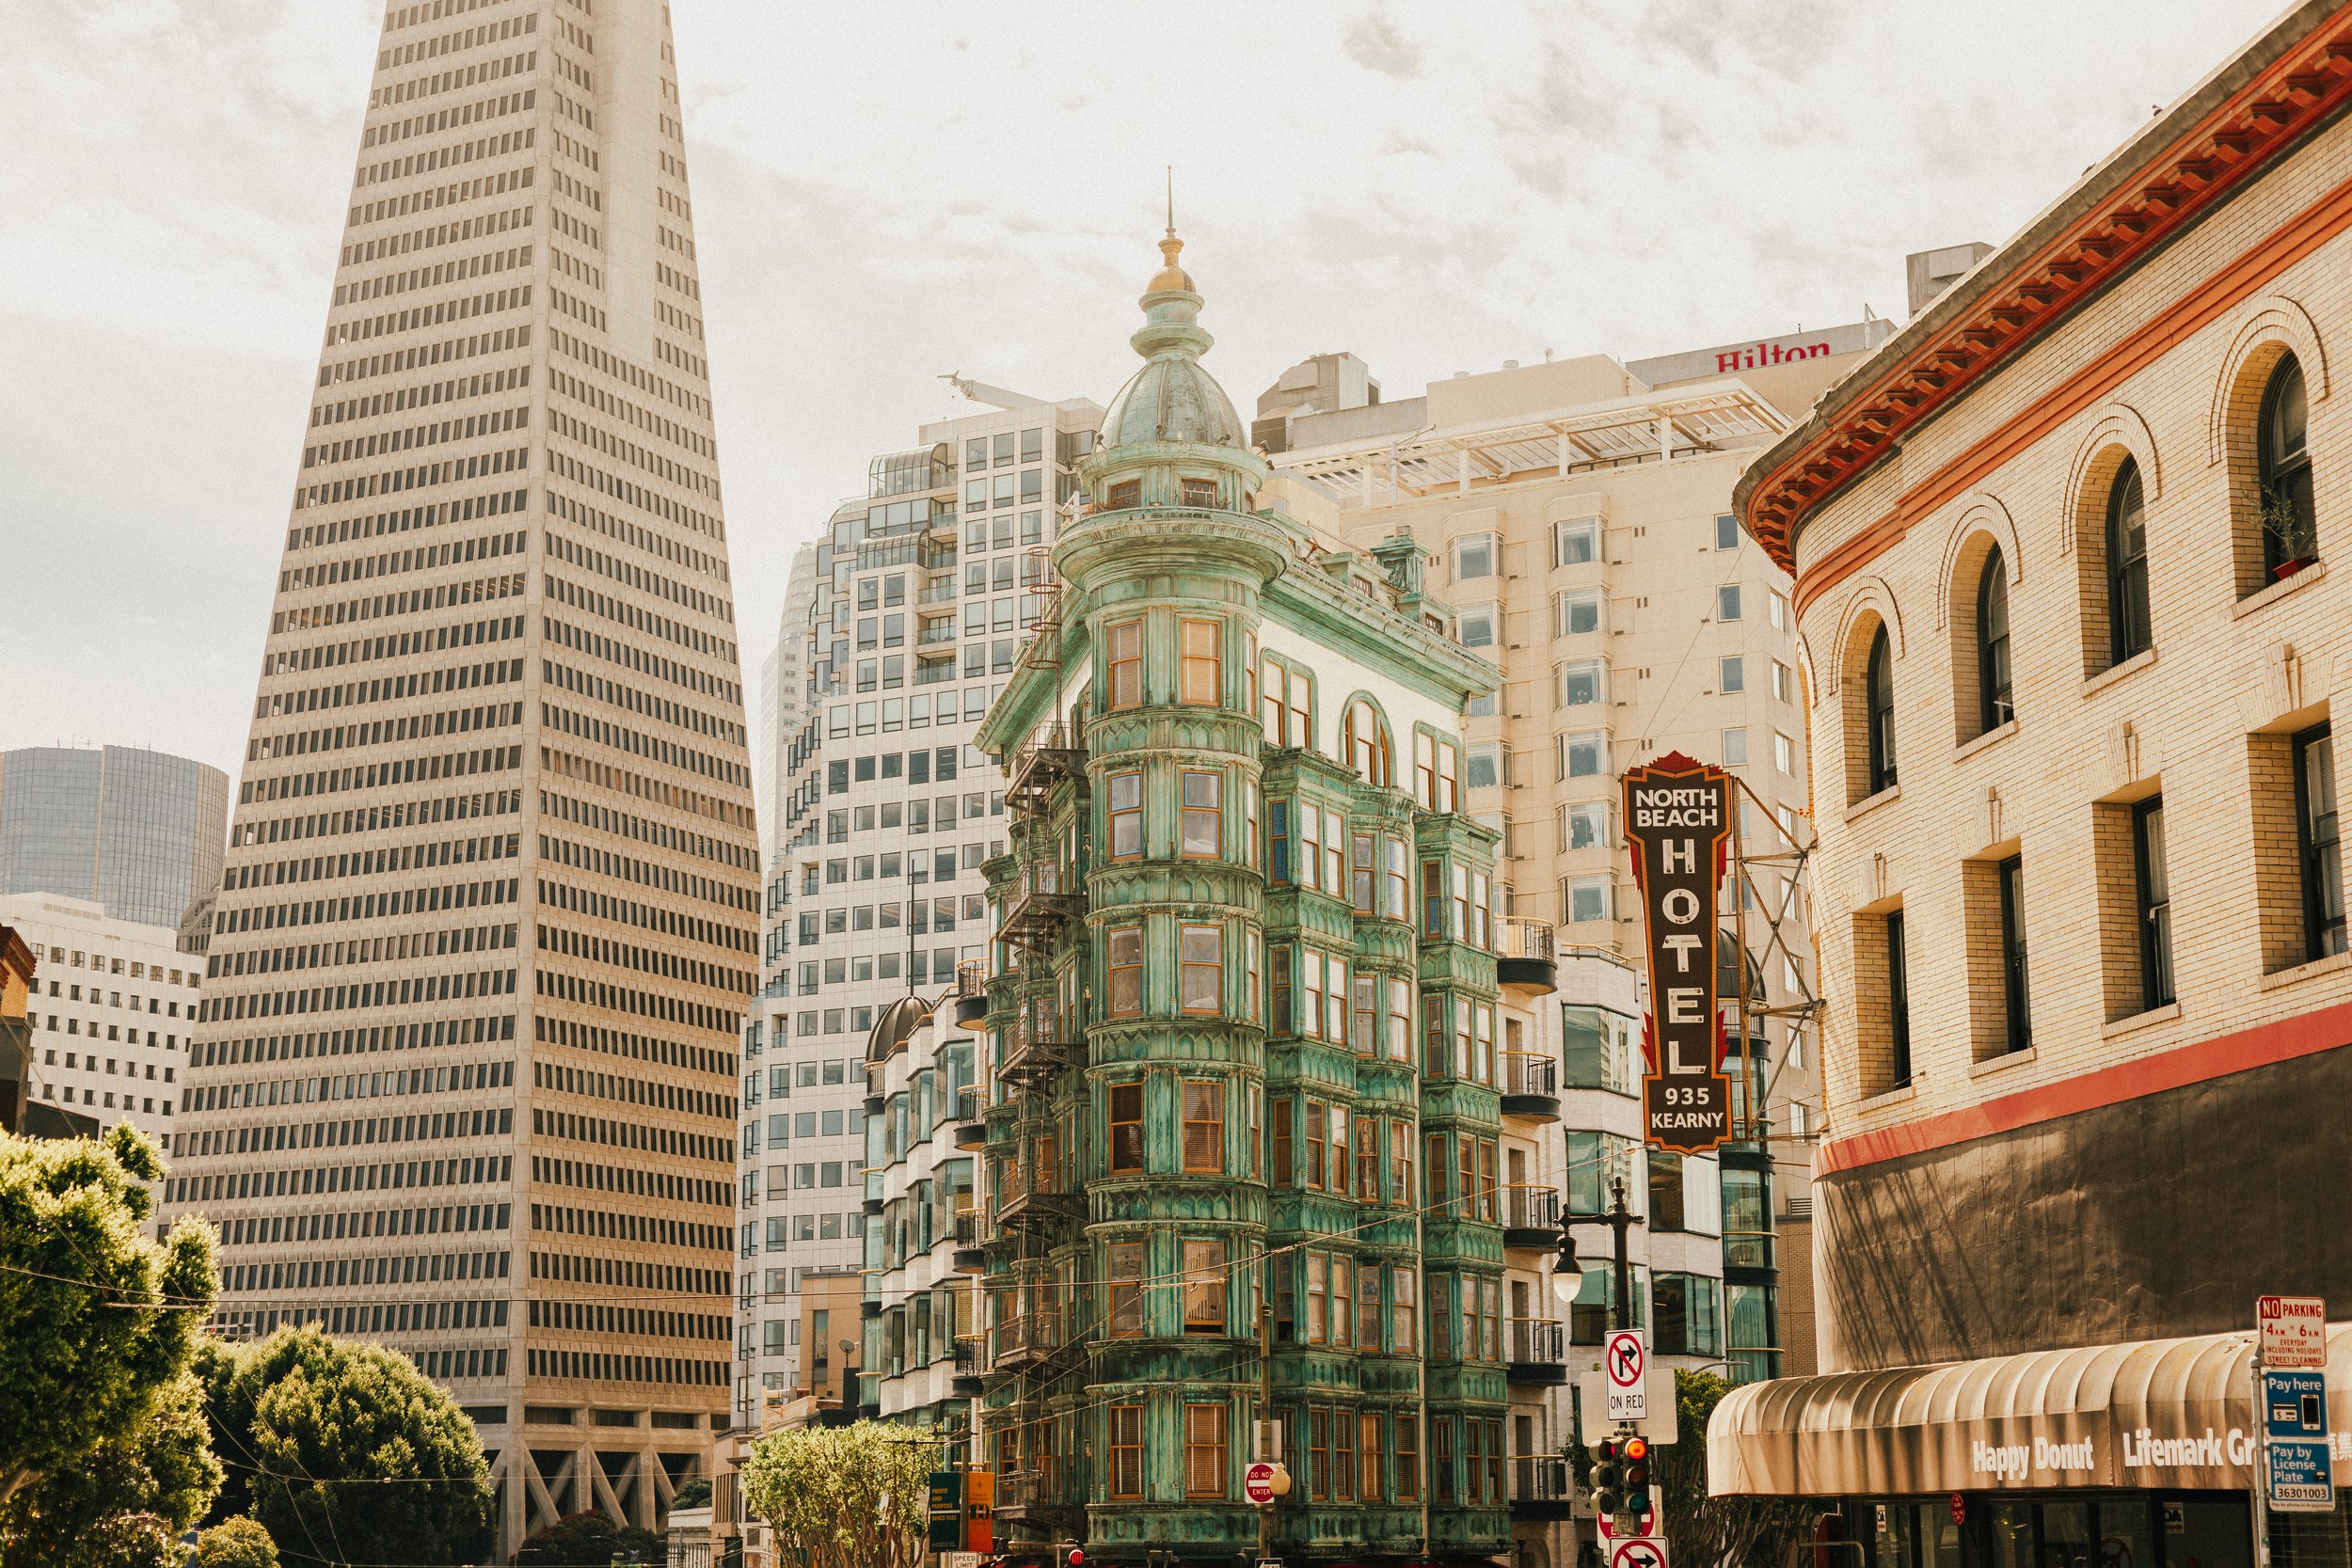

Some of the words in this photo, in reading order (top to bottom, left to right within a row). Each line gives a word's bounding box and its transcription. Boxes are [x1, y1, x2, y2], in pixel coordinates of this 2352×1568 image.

[1715, 342, 1830, 373] Hilton
[1636, 788, 1718, 807] NORTH
[1637, 809, 1718, 827] BEACH
[1661, 838, 1707, 1074] HOTEL
[1665, 1087, 1709, 1105] 935
[1651, 1112, 1724, 1129] KEARNY
[2263, 1300, 2280, 1317] NO
[2282, 1304, 2322, 1318] PARKING
[2266, 1323, 2274, 1336] 4
[2299, 1324, 2307, 1337] 6
[2265, 1346, 2296, 1354] INCLUDING
[2268, 1355, 2291, 1364] STREET
[2292, 1356, 2322, 1365] CLEANING
[2268, 1377, 2292, 1394] Pay
[2293, 1377, 2322, 1391] here
[1610, 1395, 1623, 1410] ON
[1626, 1394, 1644, 1409] RED
[1972, 1439, 2030, 1481] Happy
[2034, 1434, 2095, 1470] Donut
[2122, 1427, 2225, 1467] Lifemark
[2272, 1446, 2294, 1460] Pay
[2296, 1445, 2312, 1461] by
[2273, 1458, 2316, 1470] License
[2274, 1470, 2304, 1482] Plate
[2278, 1488, 2327, 1498] 36301003
